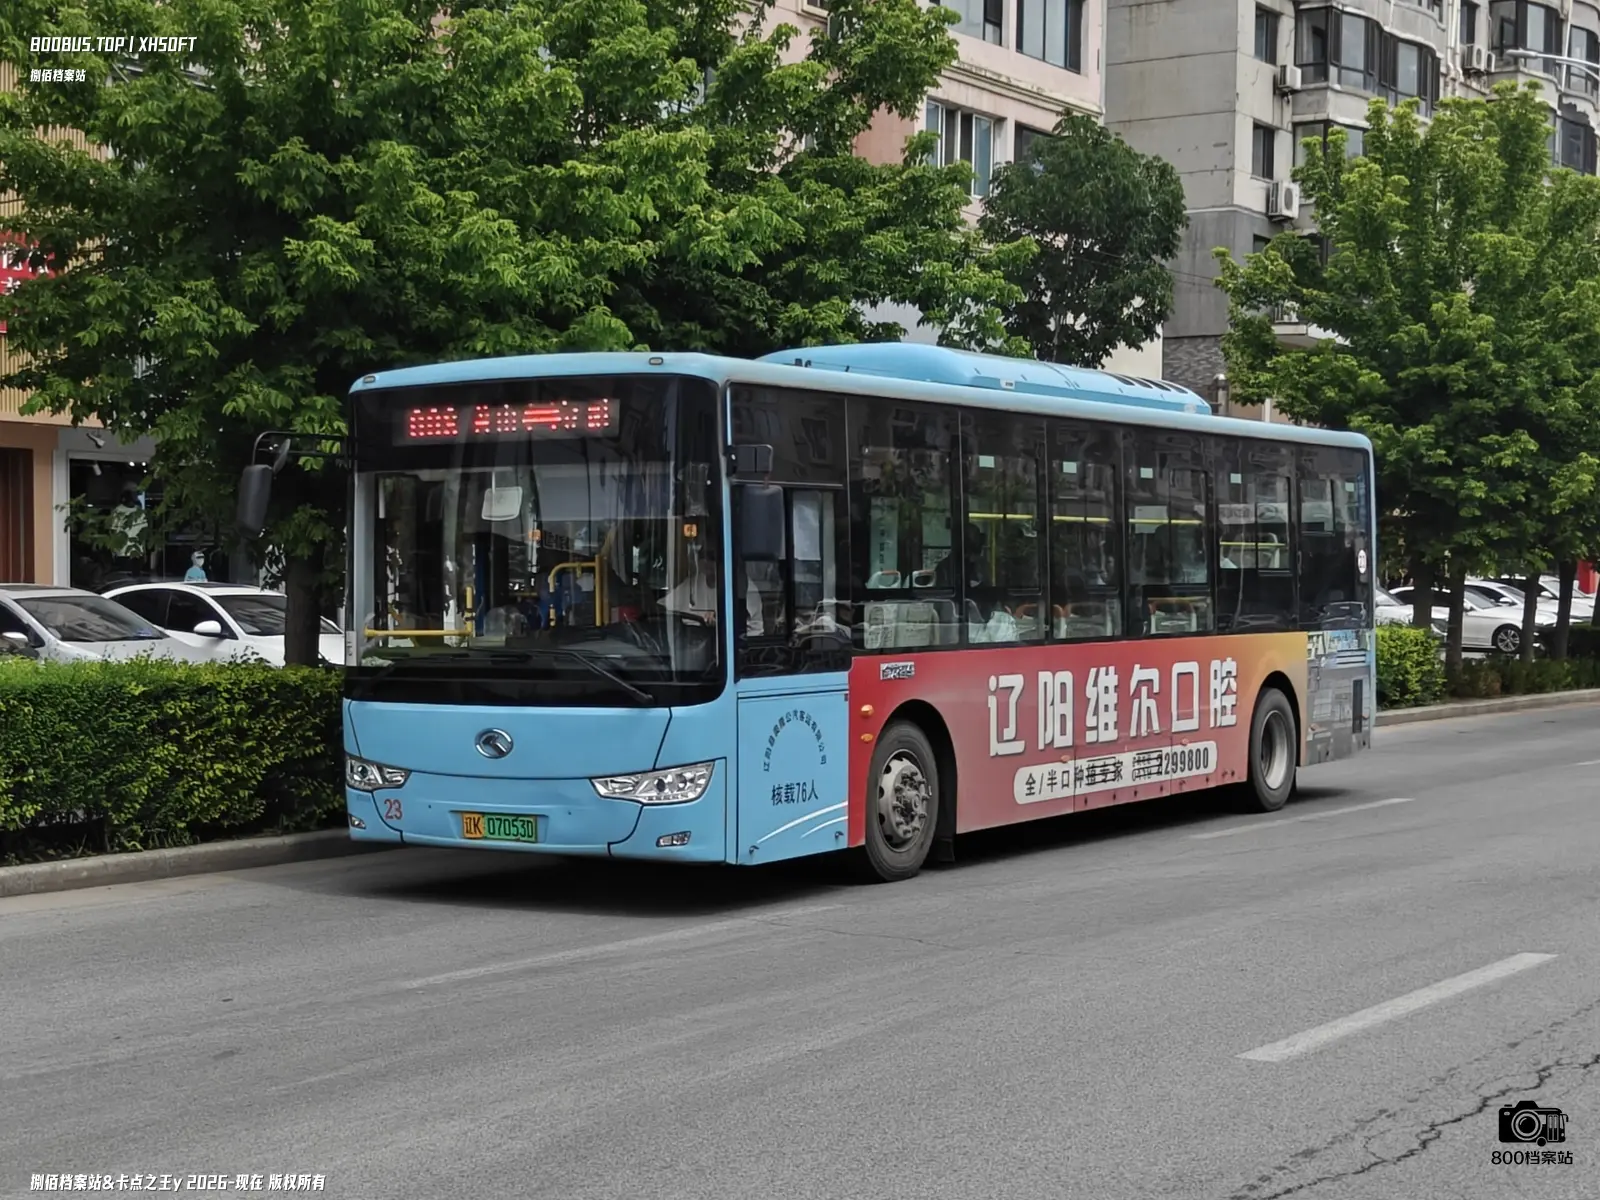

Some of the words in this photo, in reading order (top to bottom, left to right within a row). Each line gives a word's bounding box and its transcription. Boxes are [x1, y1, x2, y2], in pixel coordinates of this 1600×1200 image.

[987, 656, 1238, 757] 辽阳维尔口腔
[770, 779, 819, 806] 核载76人
[383, 798, 403, 820] 23
[464, 815, 483, 834] 辽K
[487, 816, 535, 838] 07053D
